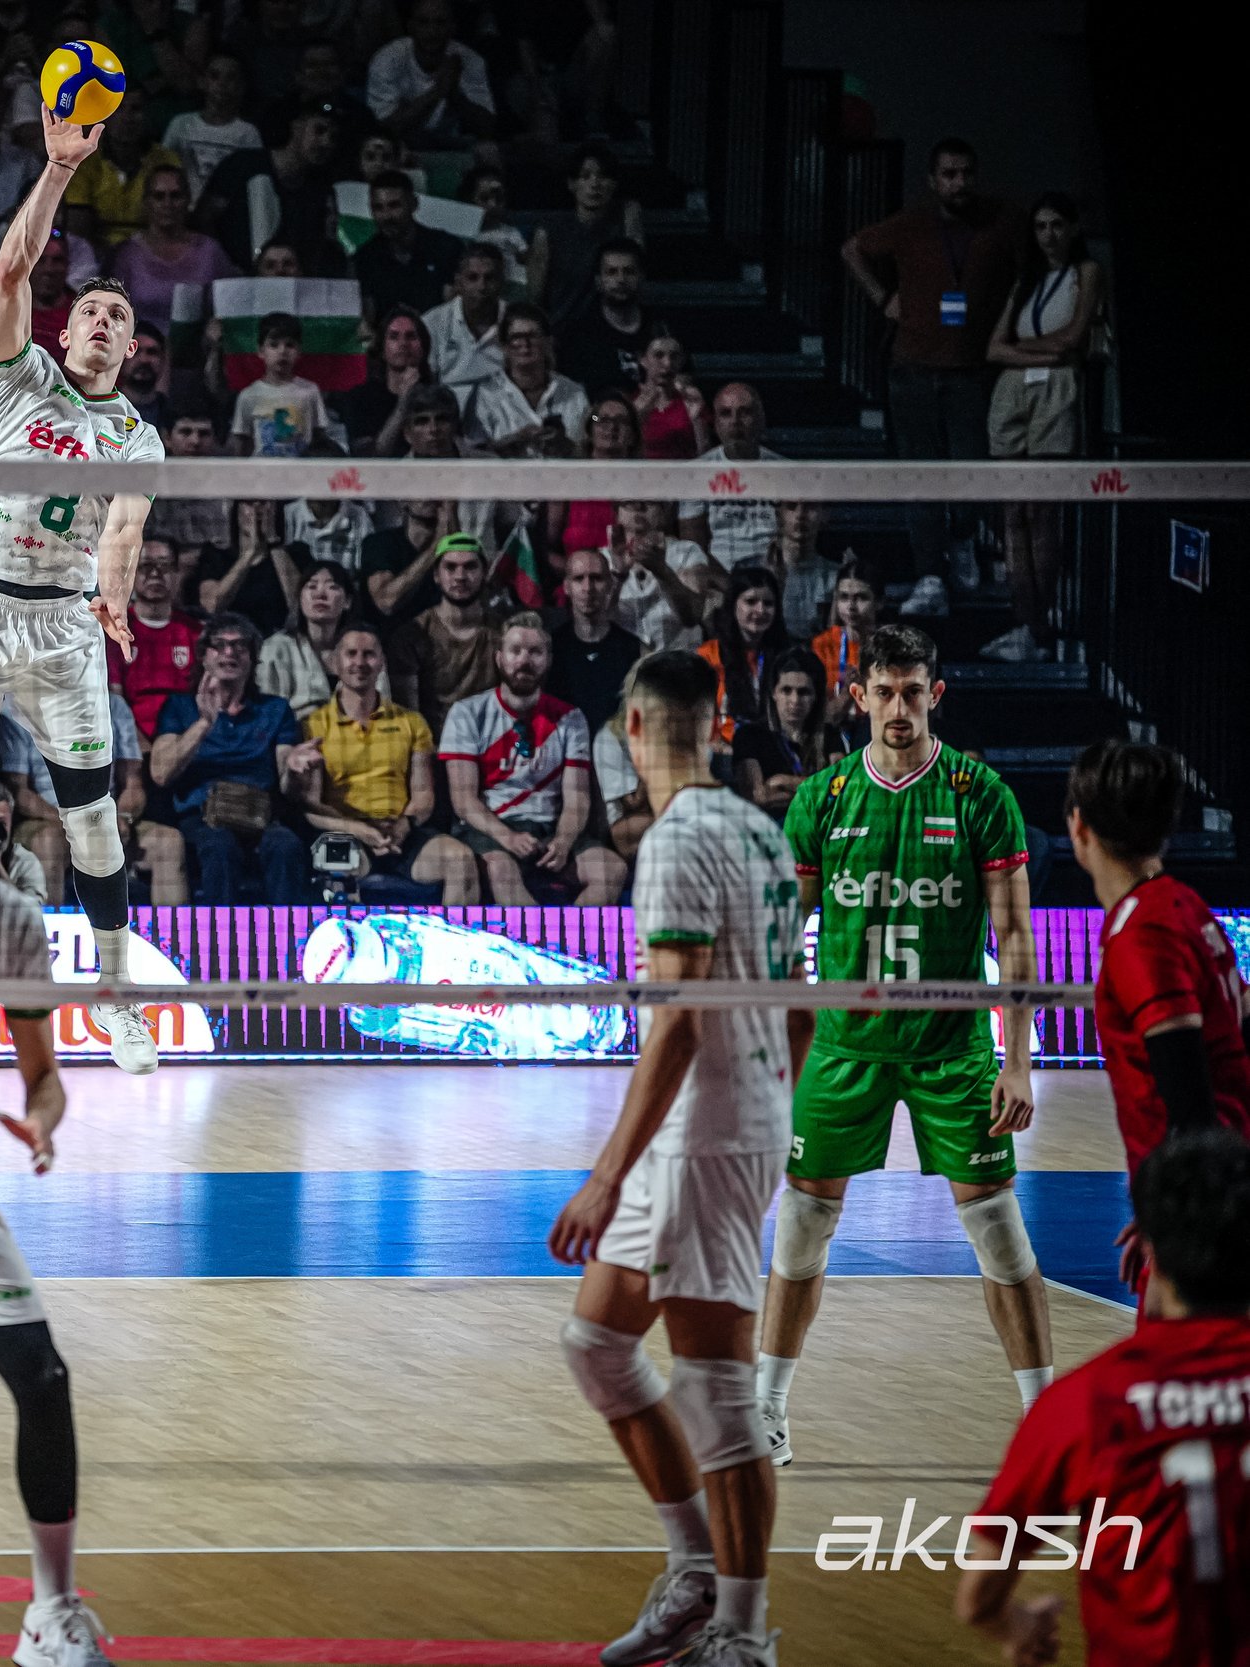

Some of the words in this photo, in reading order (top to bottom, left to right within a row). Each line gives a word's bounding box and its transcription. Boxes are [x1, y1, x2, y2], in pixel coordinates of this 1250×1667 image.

[50, 383, 83, 408] Zeus
[28, 425, 90, 462] efb
[1090, 468, 1130, 494] VNL
[69, 740, 106, 752] Zeus
[829, 826, 870, 841] Zeus
[831, 869, 963, 909] efbet
[865, 925, 921, 984] 15
[791, 1135, 806, 1160] 5
[968, 1149, 1009, 1165] Zeus
[1160, 1436, 1250, 1584] 1
